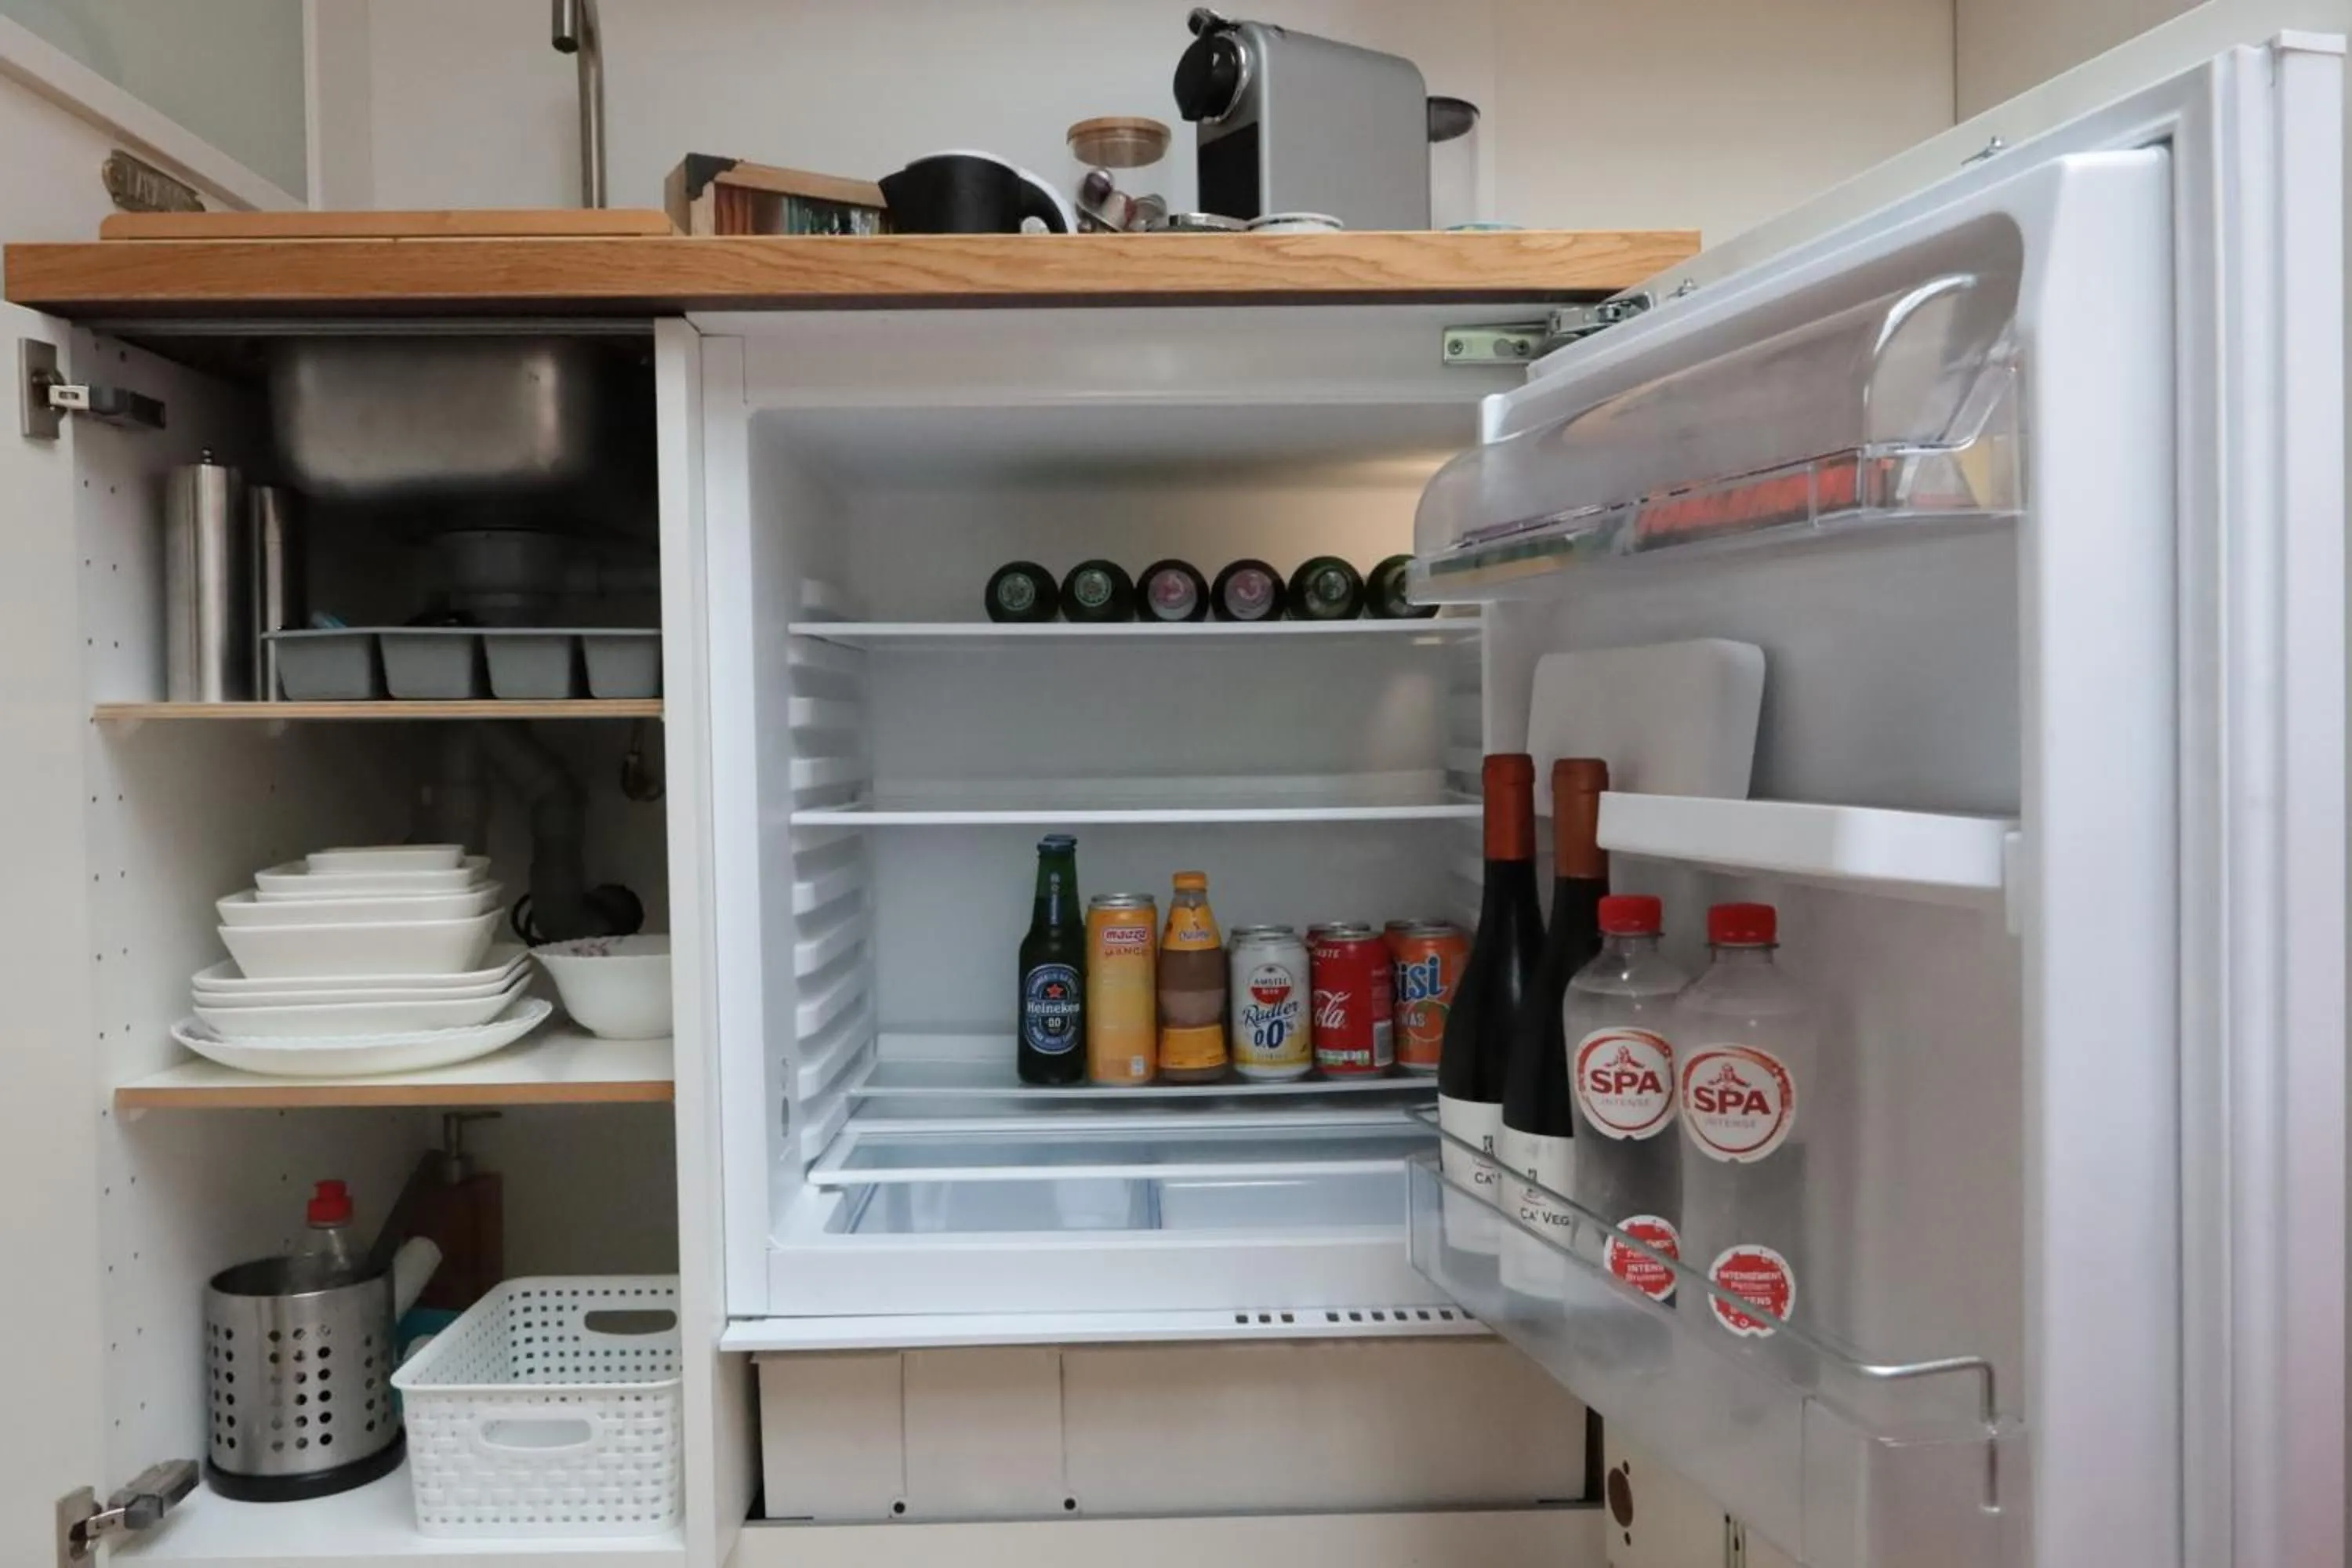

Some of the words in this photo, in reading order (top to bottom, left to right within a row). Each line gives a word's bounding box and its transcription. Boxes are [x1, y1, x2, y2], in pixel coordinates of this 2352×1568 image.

[1027, 1001, 1080, 1014] Heineken
[1243, 998, 1299, 1029] Radler
[1590, 1069, 1663, 1095] SPA
[1693, 1086, 1771, 1116] SPA
